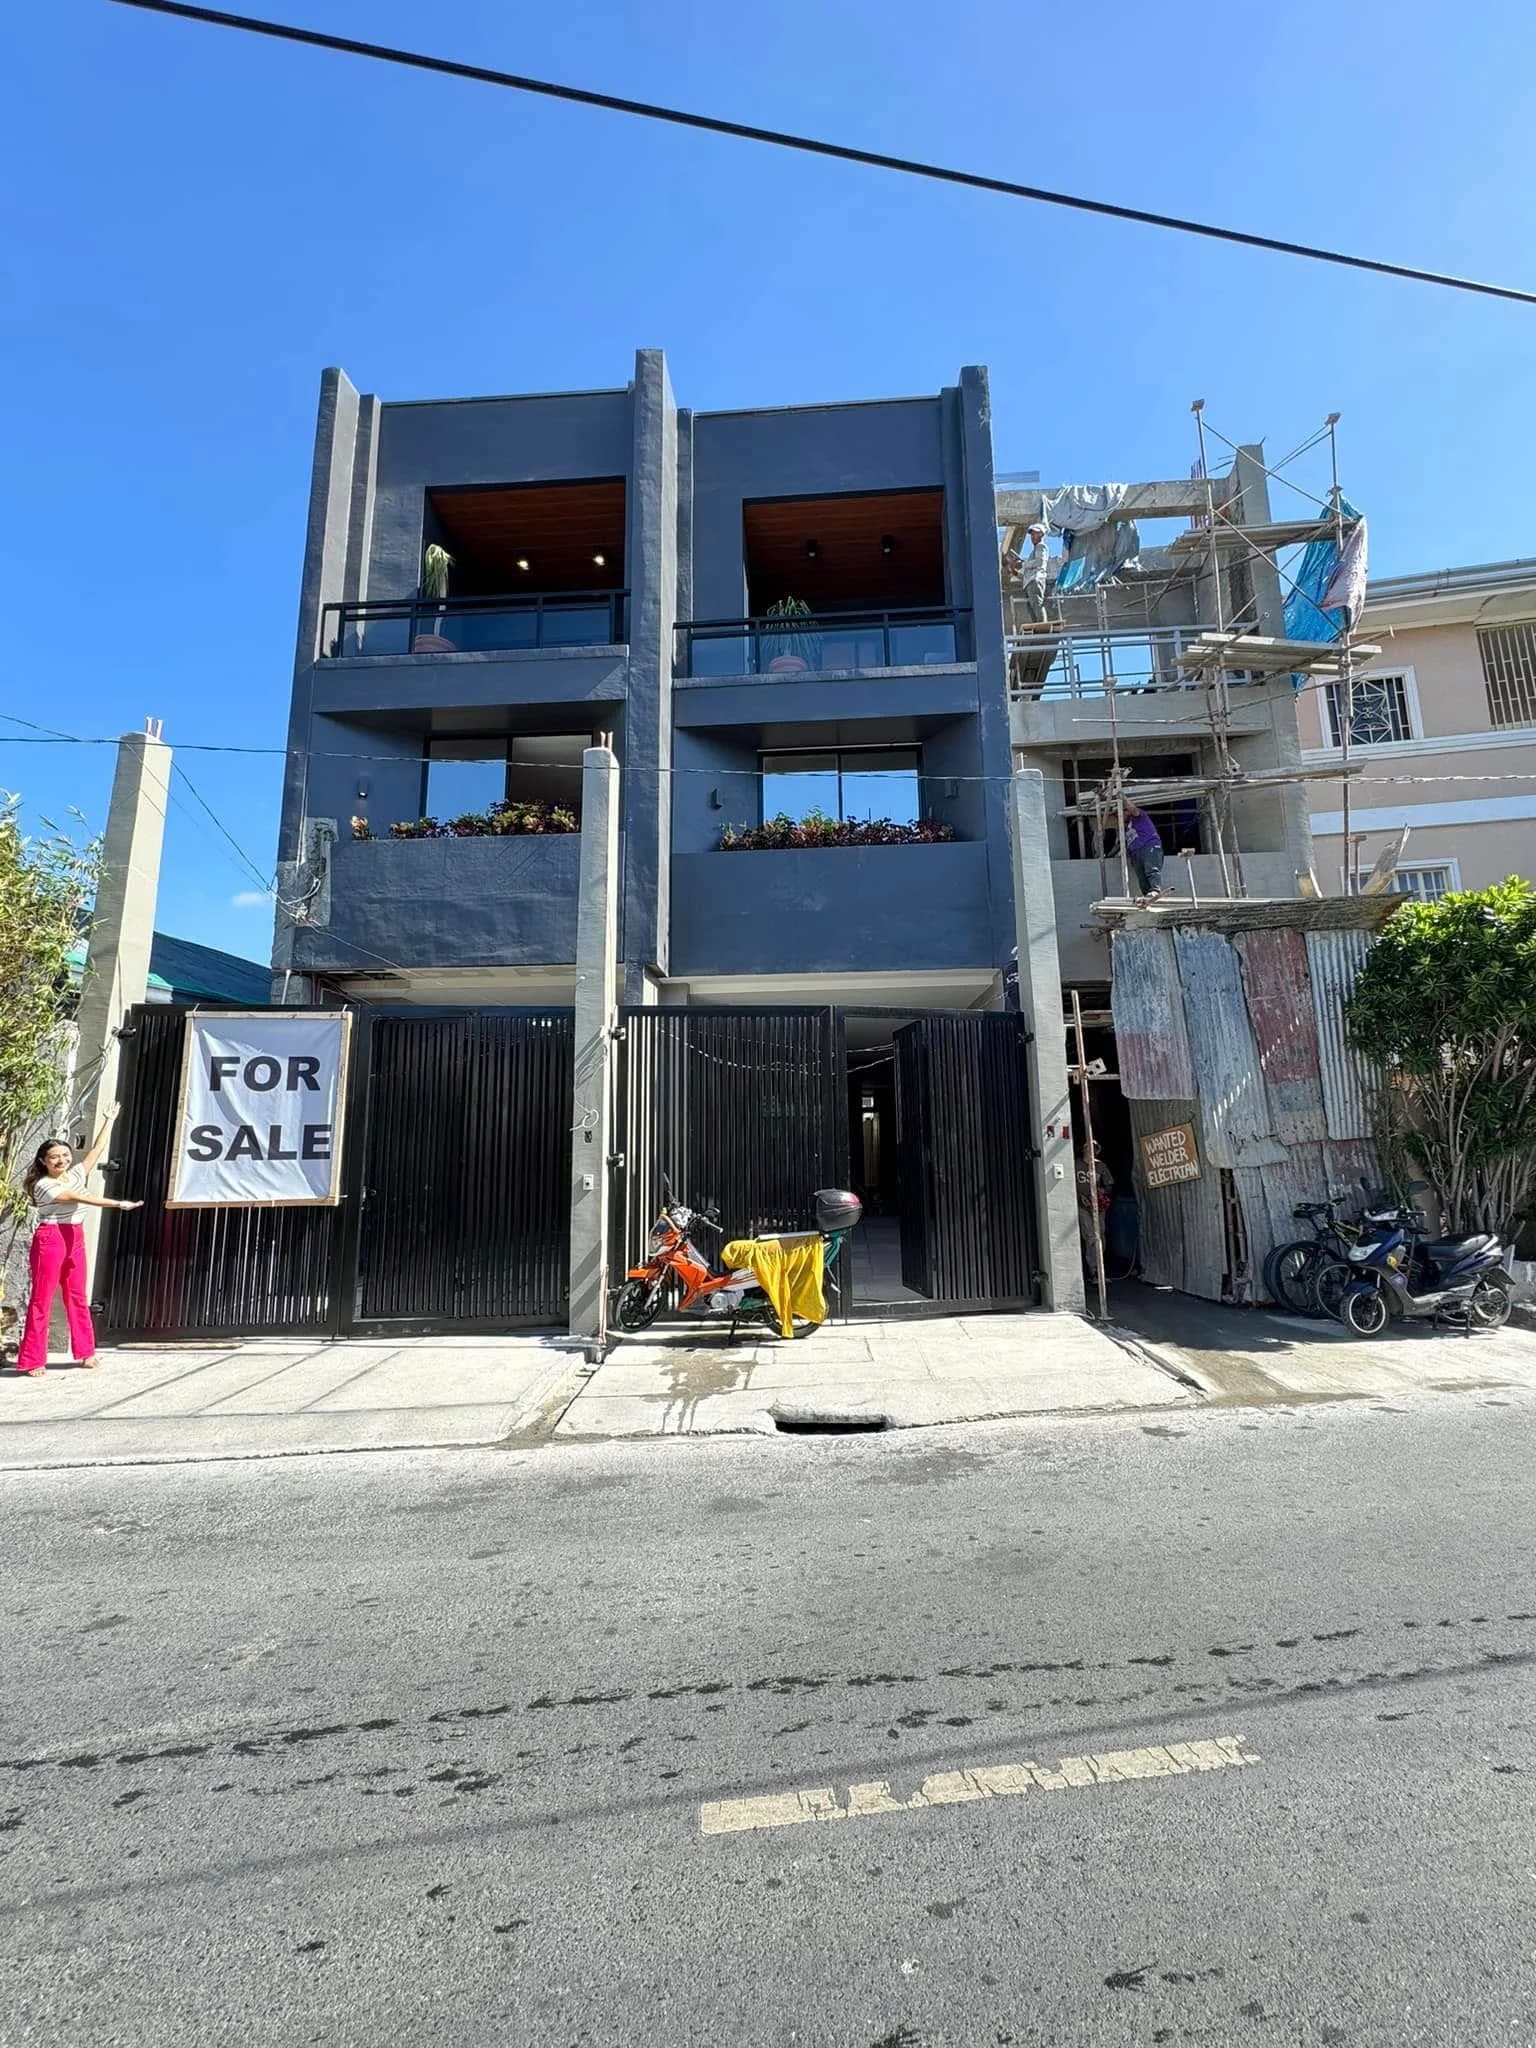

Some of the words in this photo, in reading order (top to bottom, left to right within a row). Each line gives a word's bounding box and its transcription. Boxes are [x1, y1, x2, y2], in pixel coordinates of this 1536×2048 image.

[209, 1056, 321, 1092] FOR
[187, 1124, 332, 1162] SALE
[1145, 1130, 1186, 1155] WANTED
[1149, 1147, 1189, 1169] WELDER
